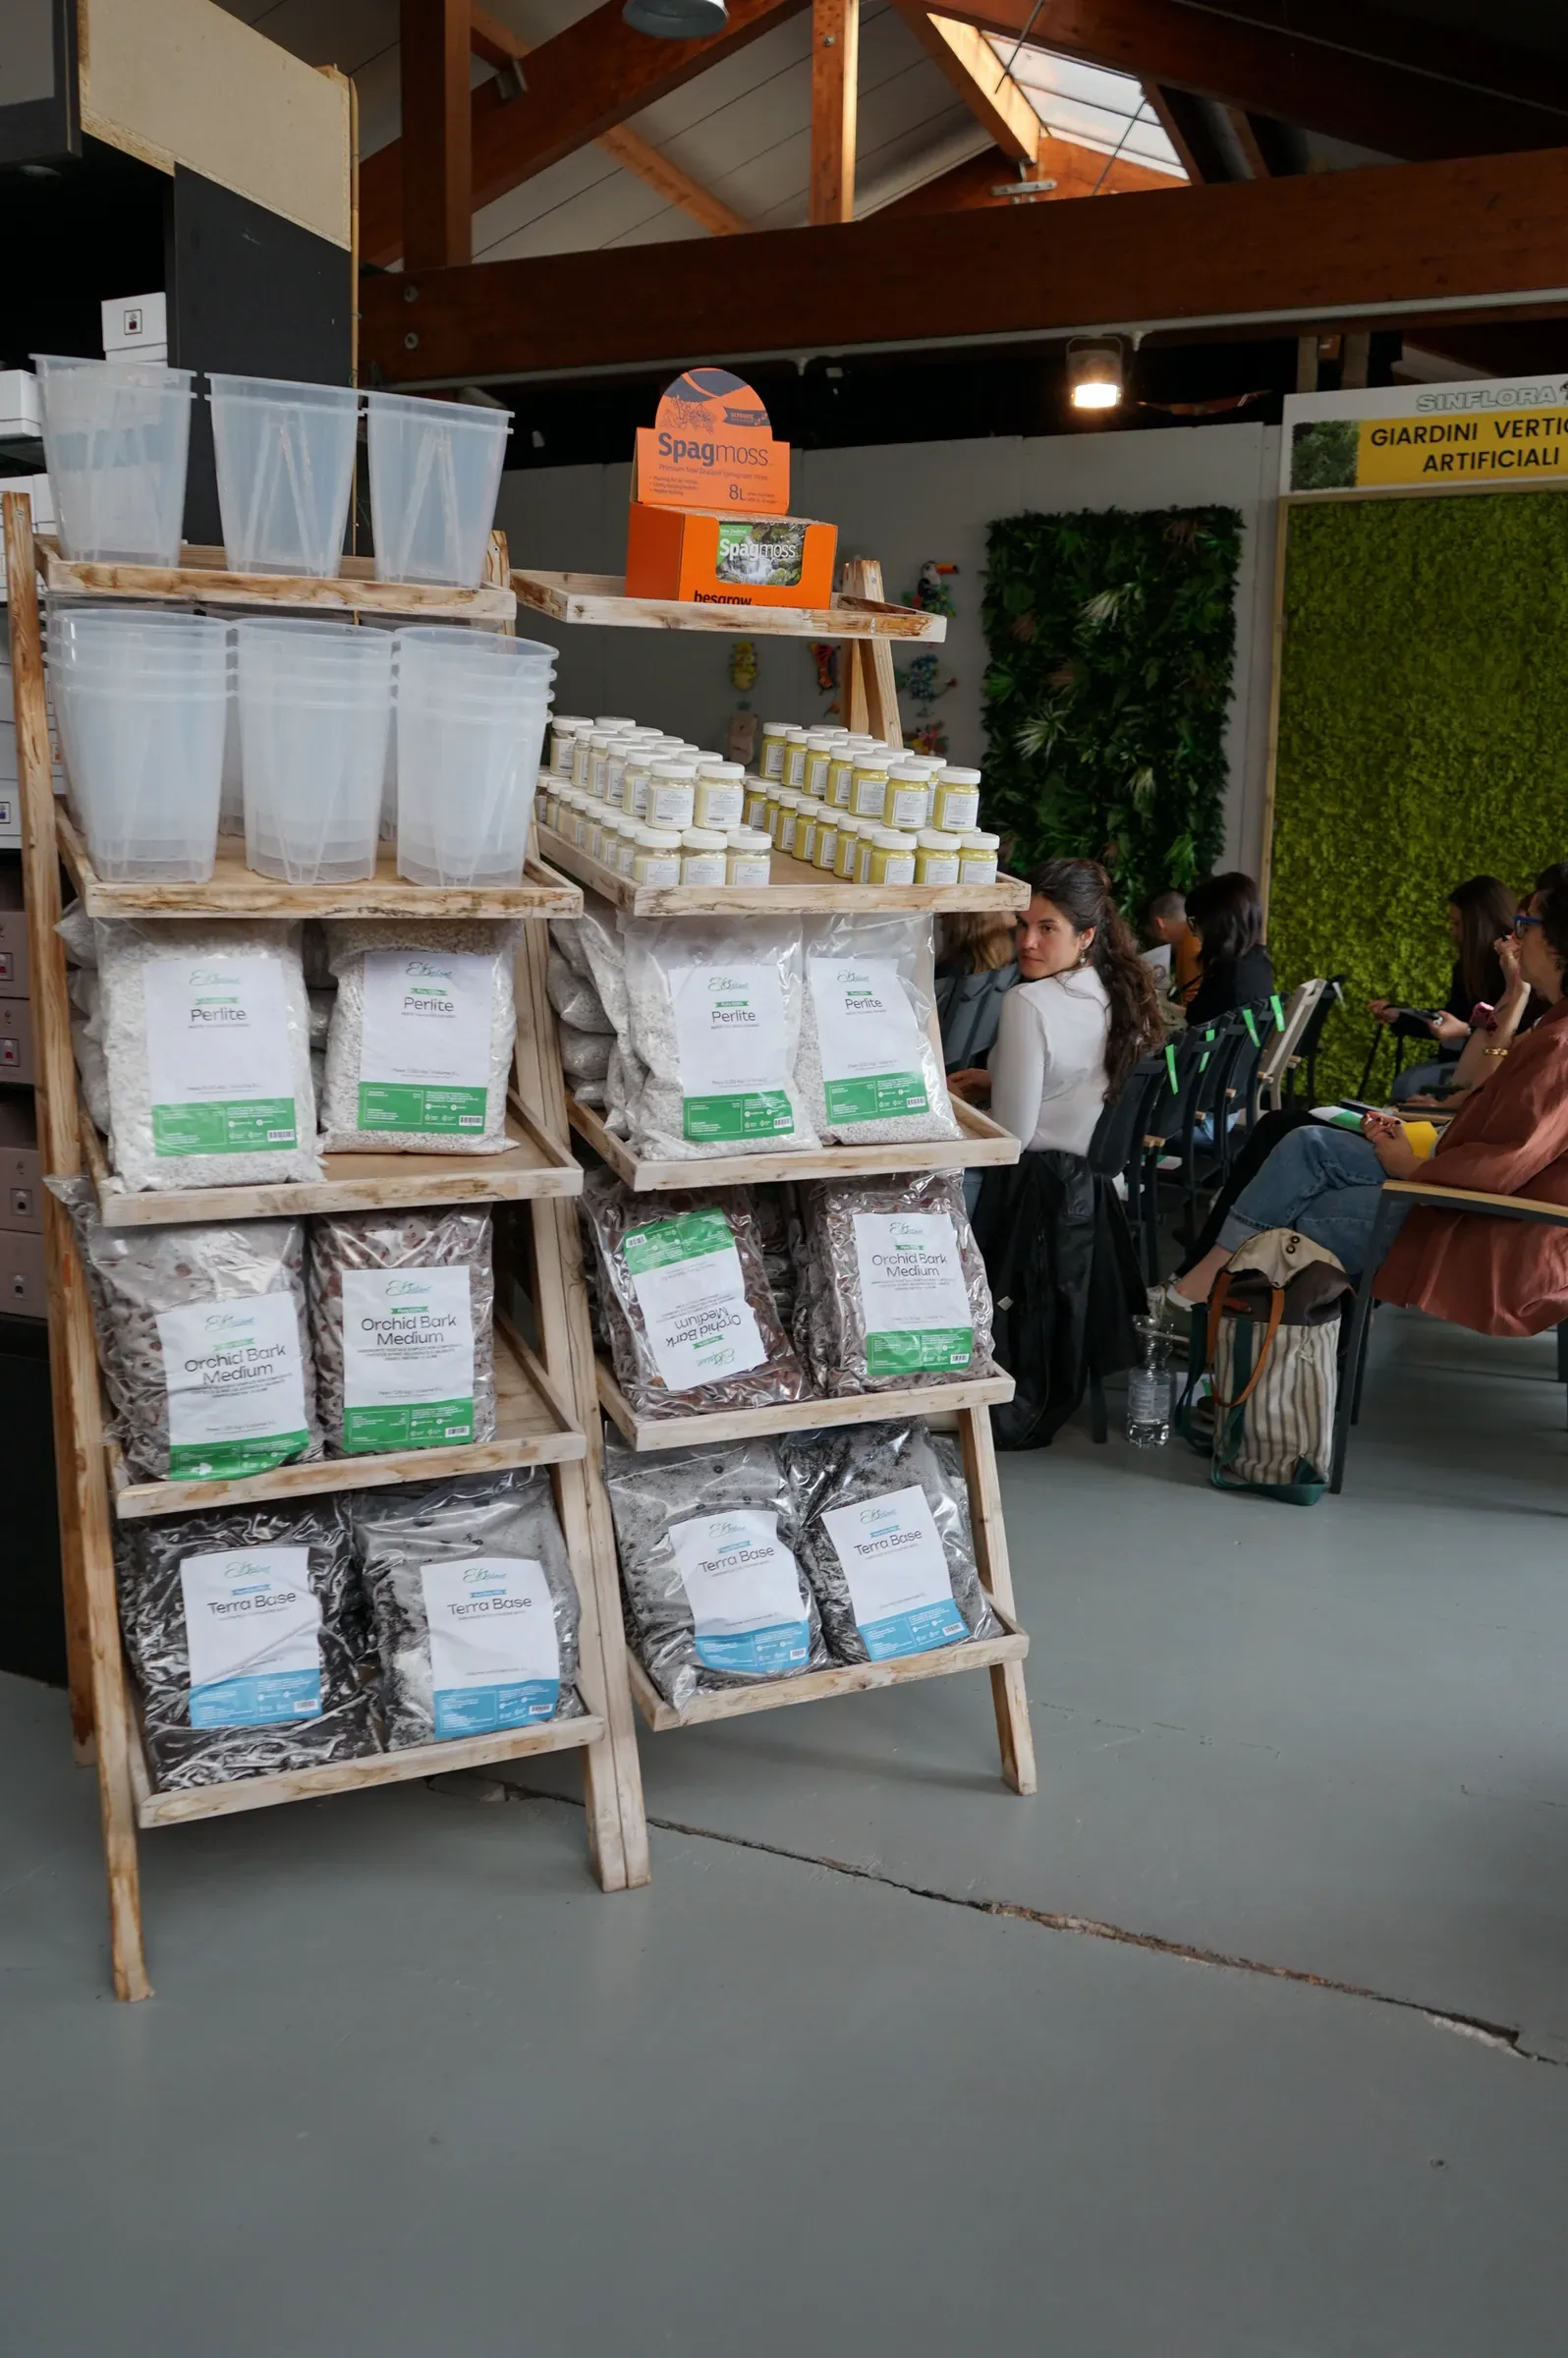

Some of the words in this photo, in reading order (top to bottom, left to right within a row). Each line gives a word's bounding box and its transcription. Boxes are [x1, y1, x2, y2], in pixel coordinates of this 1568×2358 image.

[1416, 385, 1556, 412] SINFLORA
[1371, 422, 1478, 446] GIARDINI
[1494, 417, 1568, 439] VERTI
[658, 432, 768, 467] Spagmoss
[1423, 447, 1559, 473] ARTIFICIALI
[719, 538, 796, 561] Spagmoss
[191, 1007, 247, 1023] Perlite
[404, 996, 454, 1012] Perlite
[845, 997, 883, 1010] Perlite
[711, 1009, 756, 1023] Perlite
[871, 1253, 918, 1266] Orchid
[920, 1253, 948, 1264] Bark
[886, 1265, 940, 1278] Medium
[361, 1317, 417, 1331] Orchid
[420, 1315, 457, 1328] Bark
[674, 1306, 729, 1329] Medium
[700, 1314, 742, 1338] Orchid
[376, 1331, 444, 1346] Medium
[665, 1327, 698, 1348] Bark
[184, 1350, 245, 1373] Orchid
[247, 1343, 287, 1363] Bark
[202, 1362, 274, 1385] Medium
[854, 1540, 889, 1556] Terra
[890, 1529, 923, 1546] Base
[699, 1557, 738, 1573] Terra
[739, 1546, 775, 1563] Base
[206, 1600, 252, 1615] Terra
[254, 1591, 297, 1608] Base
[447, 1602, 489, 1616] Terra
[493, 1597, 532, 1610] Base
